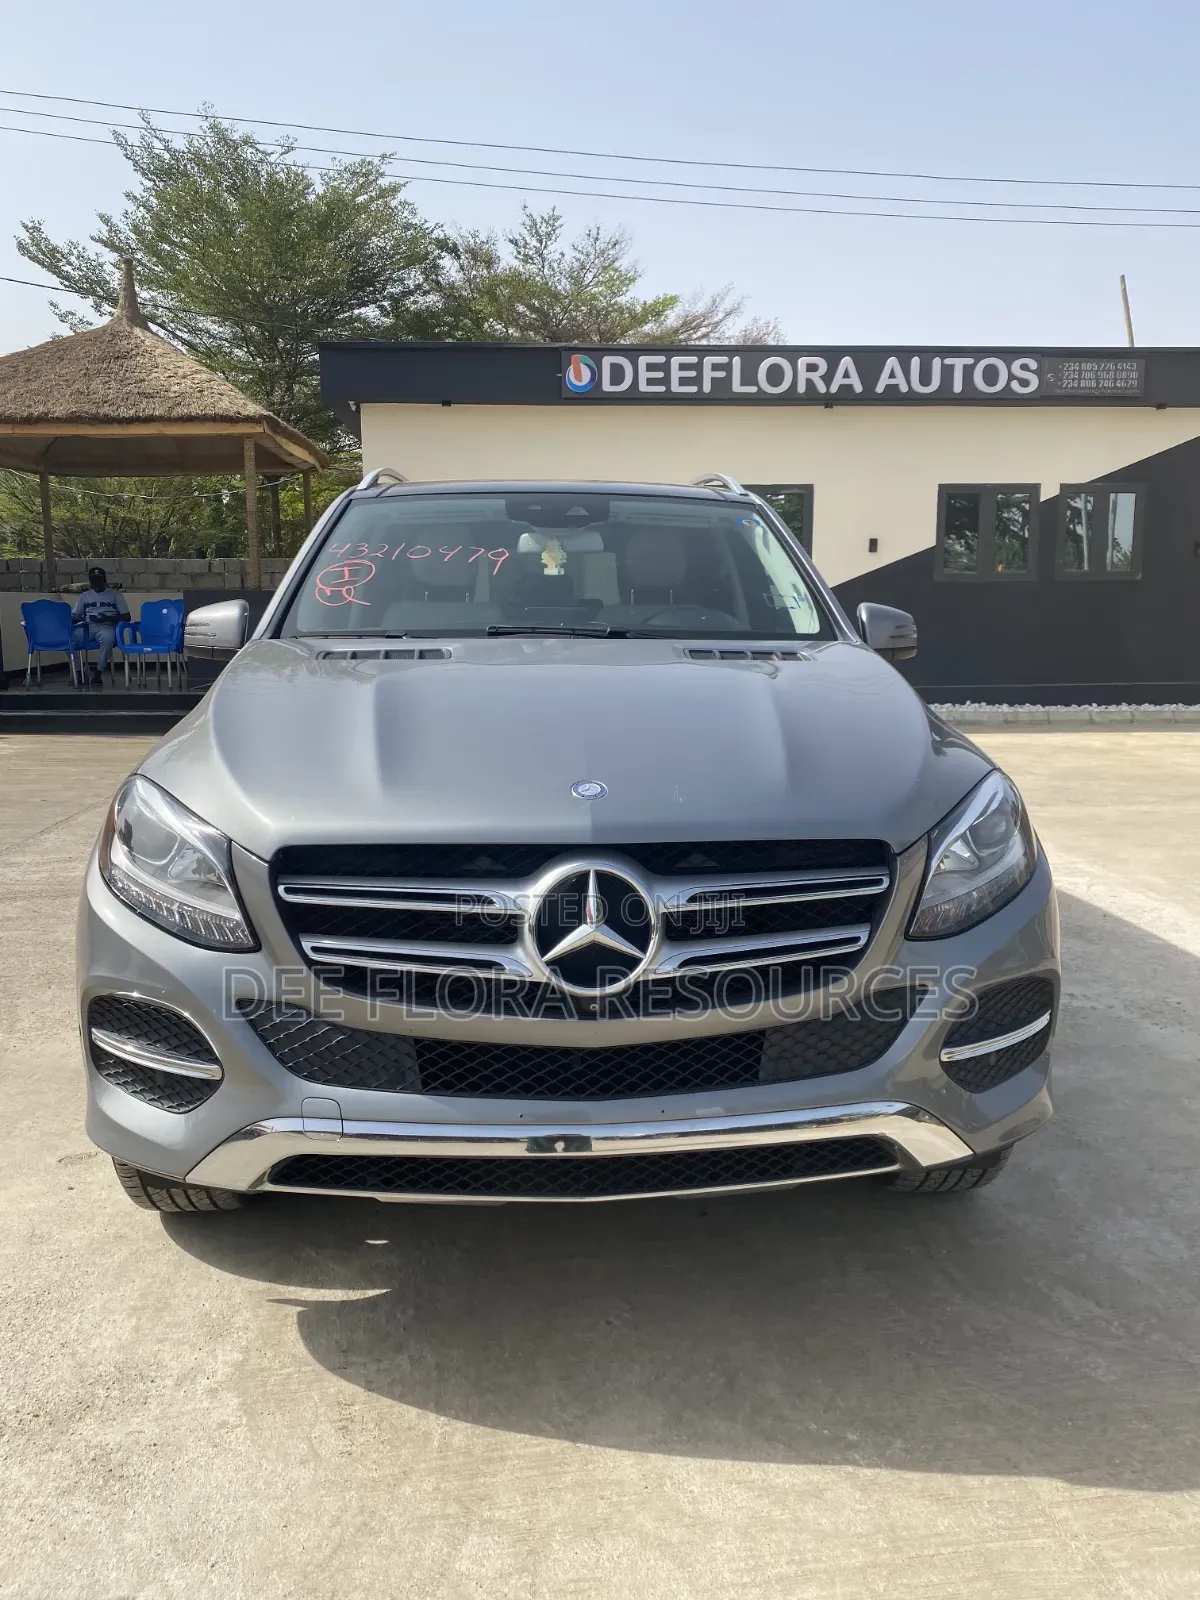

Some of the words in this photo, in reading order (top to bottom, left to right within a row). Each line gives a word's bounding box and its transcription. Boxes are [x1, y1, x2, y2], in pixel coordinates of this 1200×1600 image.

[602, 356, 863, 393] DEEFLORA
[875, 356, 1040, 394] AUTOS
[329, 543, 509, 576] 43210479
